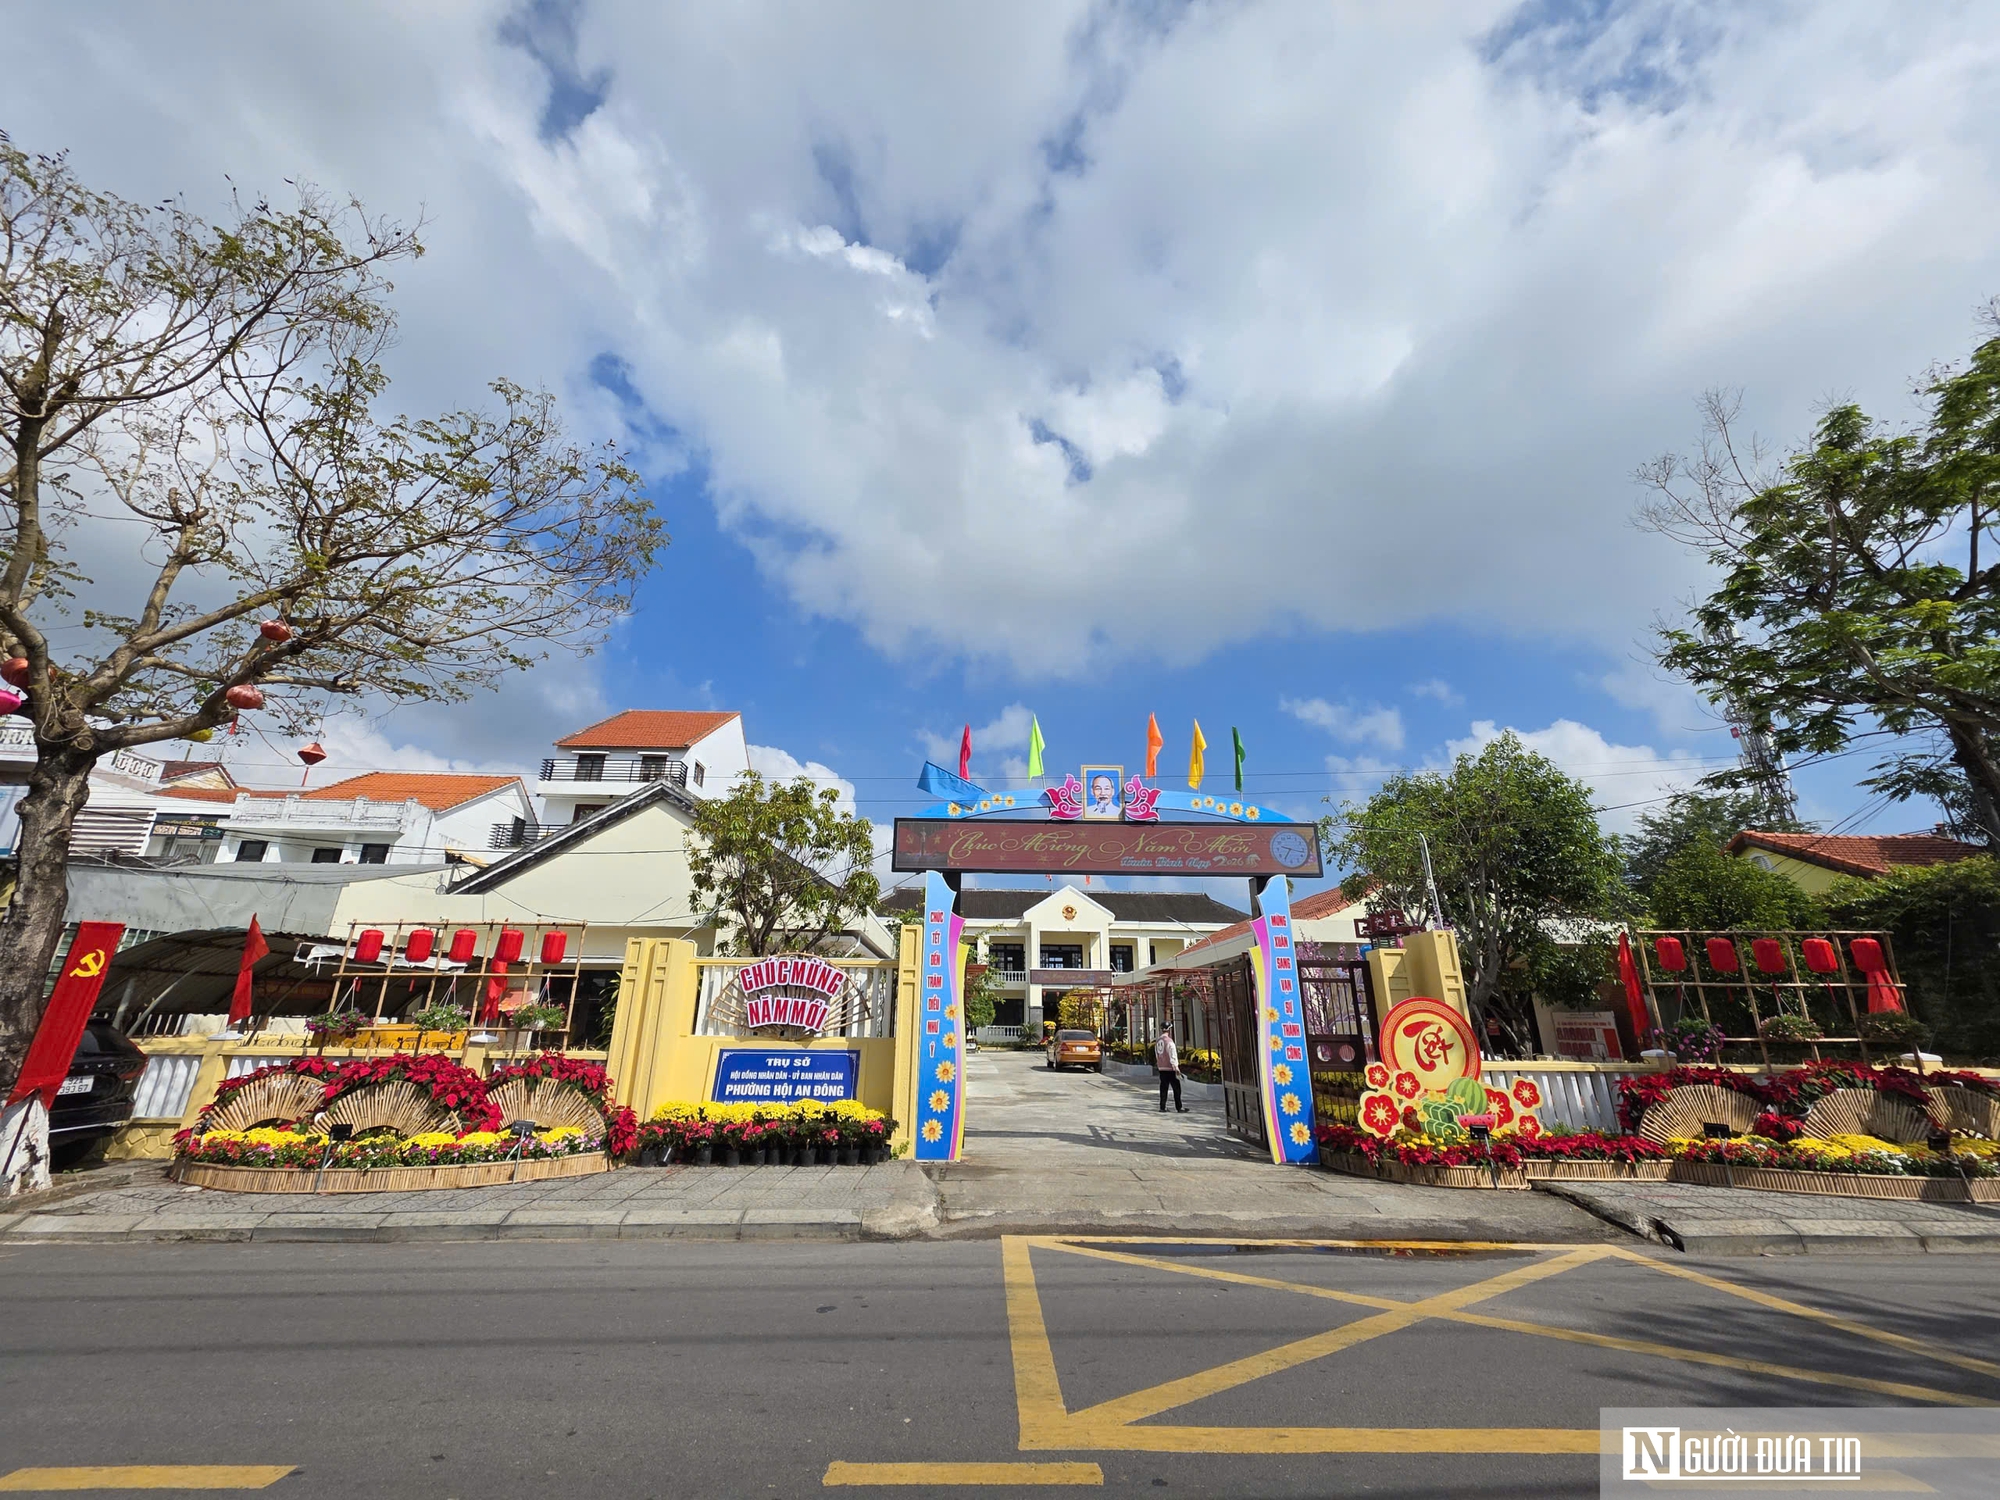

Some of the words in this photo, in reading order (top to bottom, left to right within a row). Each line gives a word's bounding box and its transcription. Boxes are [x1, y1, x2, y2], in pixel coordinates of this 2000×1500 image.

[949, 829, 998, 860] Chúc
[1000, 831, 1090, 867] Mừng
[1184, 832, 1257, 854] Mới
[1212, 855, 1244, 868] 2026
[930, 909, 944, 923] CHÚC
[1270, 914, 1287, 927] MỪNG
[931, 930, 941, 944] TẾT
[1273, 935, 1289, 948] XUÂN
[930, 951, 941, 966] ĐẾN
[1276, 957, 1291, 970] SANG
[740, 957, 789, 992] CHÚC
[790, 958, 844, 996] MỪNG
[1280, 979, 1293, 994] VẠN
[748, 996, 789, 1026] NĂM
[790, 999, 828, 1030] MỚI
[1282, 1022, 1300, 1037] THÀNH
[1286, 1045, 1302, 1060] CÔNG
[1403, 1020, 1454, 1072] Tết
[766, 1058, 790, 1068] TRỤ
[793, 1056, 811, 1066] SỞ
[730, 1070, 741, 1081] HỘI
[758, 1070, 774, 1080] NHÂN
[775, 1070, 788, 1080] DÂN
[800, 1072, 813, 1080] BAN
[814, 1071, 830, 1080] NHÂN
[831, 1071, 843, 1080] DÂN
[725, 1082, 771, 1096] PHƯỜNG
[773, 1082, 792, 1098] HỘI
[794, 1085, 812, 1096] AN
[813, 1083, 844, 1097] ĐÔNG
